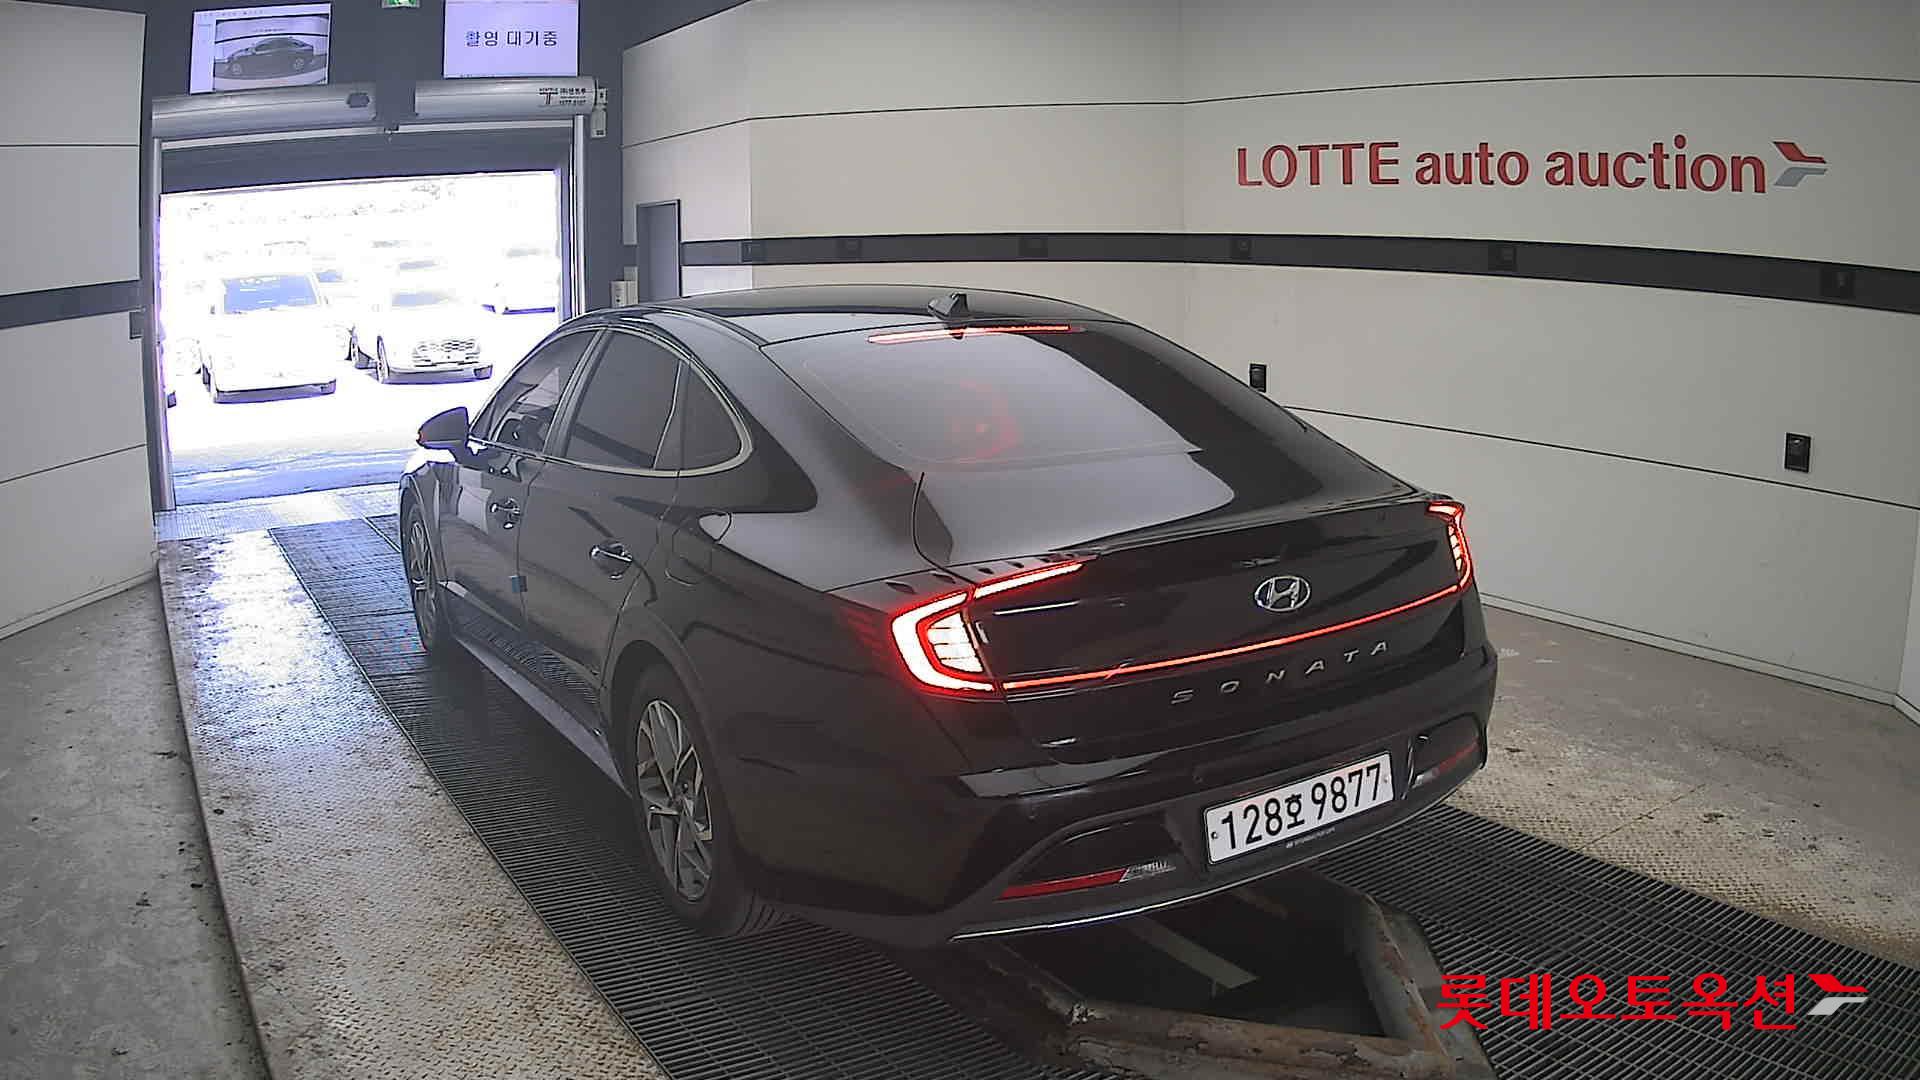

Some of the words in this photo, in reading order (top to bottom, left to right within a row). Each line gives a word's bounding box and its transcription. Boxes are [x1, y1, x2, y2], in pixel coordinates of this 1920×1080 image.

[506, 30, 558, 48] 대기중
[1237, 142, 1400, 188] LOTTE
[1415, 142, 1529, 186] auto
[1545, 134, 1766, 194] auction
[1171, 641, 1388, 705] SONATA
